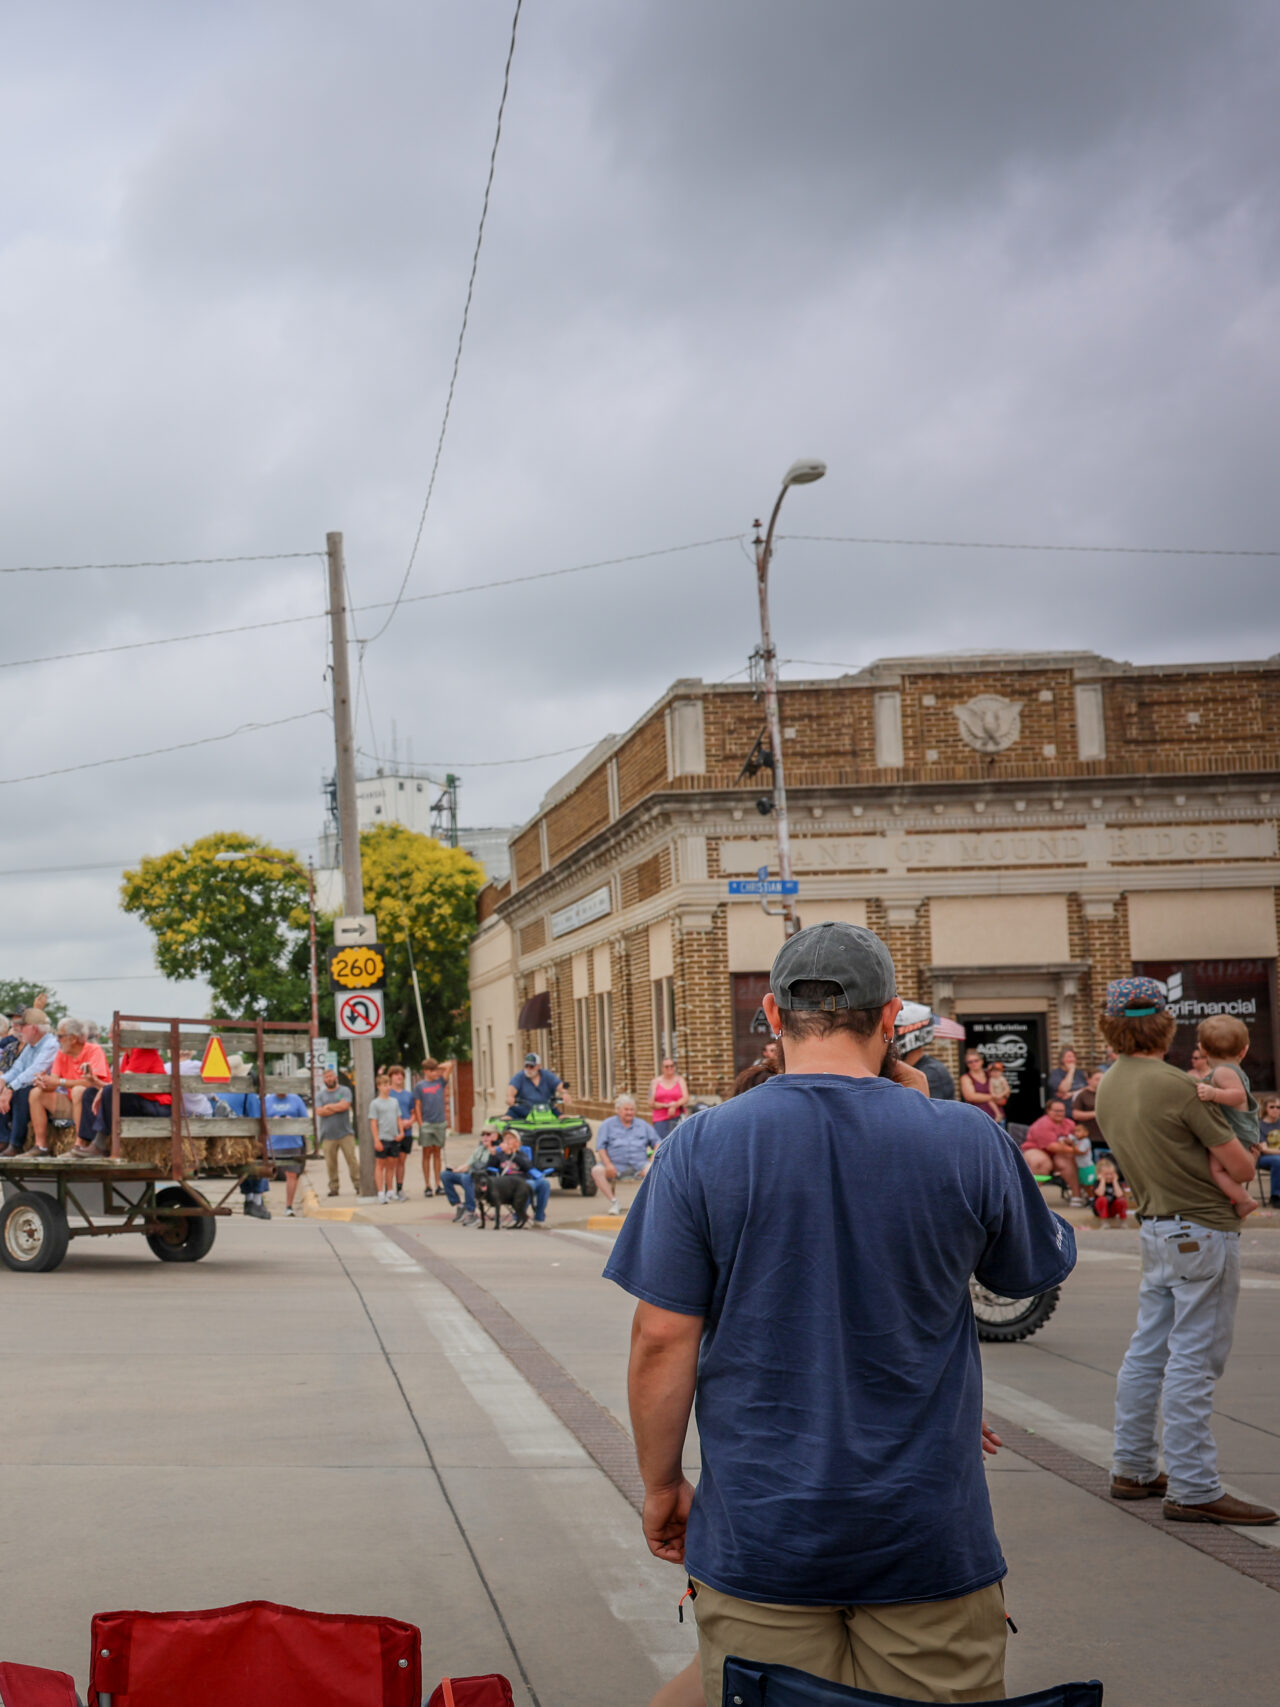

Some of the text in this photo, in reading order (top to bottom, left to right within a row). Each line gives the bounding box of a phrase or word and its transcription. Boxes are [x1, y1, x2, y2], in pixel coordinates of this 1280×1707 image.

[765, 831, 1230, 866] BANK OF MOUND RIDGE
[740, 882, 782, 893] CHRISTIAN
[336, 957, 377, 977] 260
[1164, 998, 1257, 1019] griFinancial
